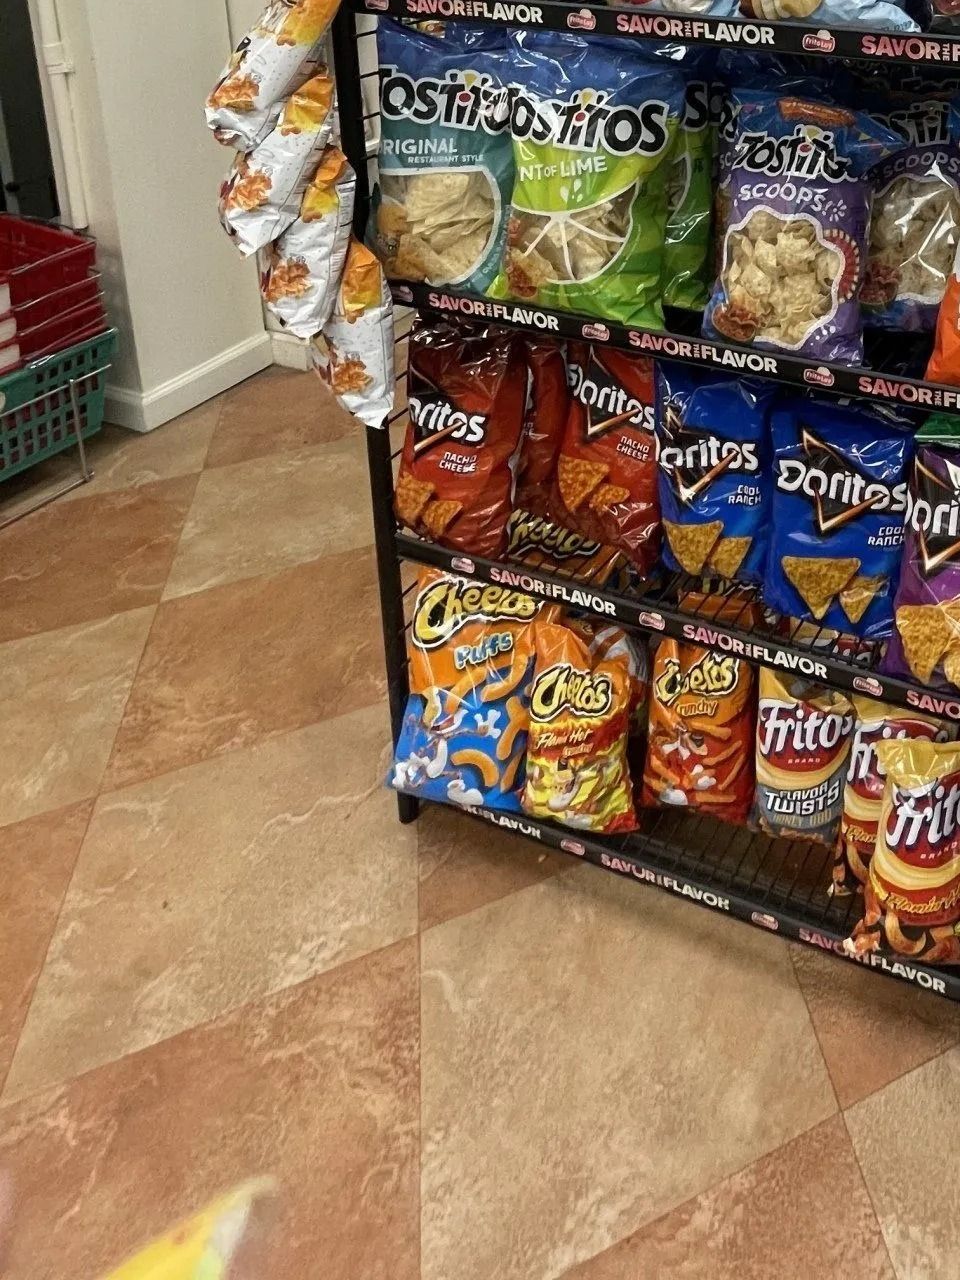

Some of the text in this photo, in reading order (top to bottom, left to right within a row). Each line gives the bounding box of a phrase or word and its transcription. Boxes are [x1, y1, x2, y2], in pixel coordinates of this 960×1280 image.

[473, 1, 543, 24] FLAVOR
[617, 13, 775, 45] SAVOR FLAVOR
[861, 35, 940, 61] SAVOR
[407, 153, 484, 165] RESTAURANT STYLE
[560, 155, 607, 176] LIME
[429, 293, 485, 316] SAVOR
[493, 303, 559, 331] FLAVOR
[629, 331, 778, 374] SAVOR FLAVOR
[858, 376, 933, 406] SAVOR
[443, 451, 477, 465] NACHO
[616, 443, 650, 463] CHEESE
[620, 435, 650, 453] NACHO
[439, 460, 476, 473] CHEESE
[727, 494, 762, 506] RANCH
[737, 484, 761, 496] COOL
[777, 459, 907, 511] Doritos
[489, 568, 617, 616] SAVOR FLAVOR
[414, 581, 537, 642] Cheetos
[455, 632, 514, 670] Puffs
[682, 624, 828, 679] SAVOR FLAVOR
[531, 666, 608, 717] Cheetos
[765, 780, 840, 815] TWISTS
[780, 783, 828, 800] FLAVOR
[870, 953, 946, 994] FLAVOR
